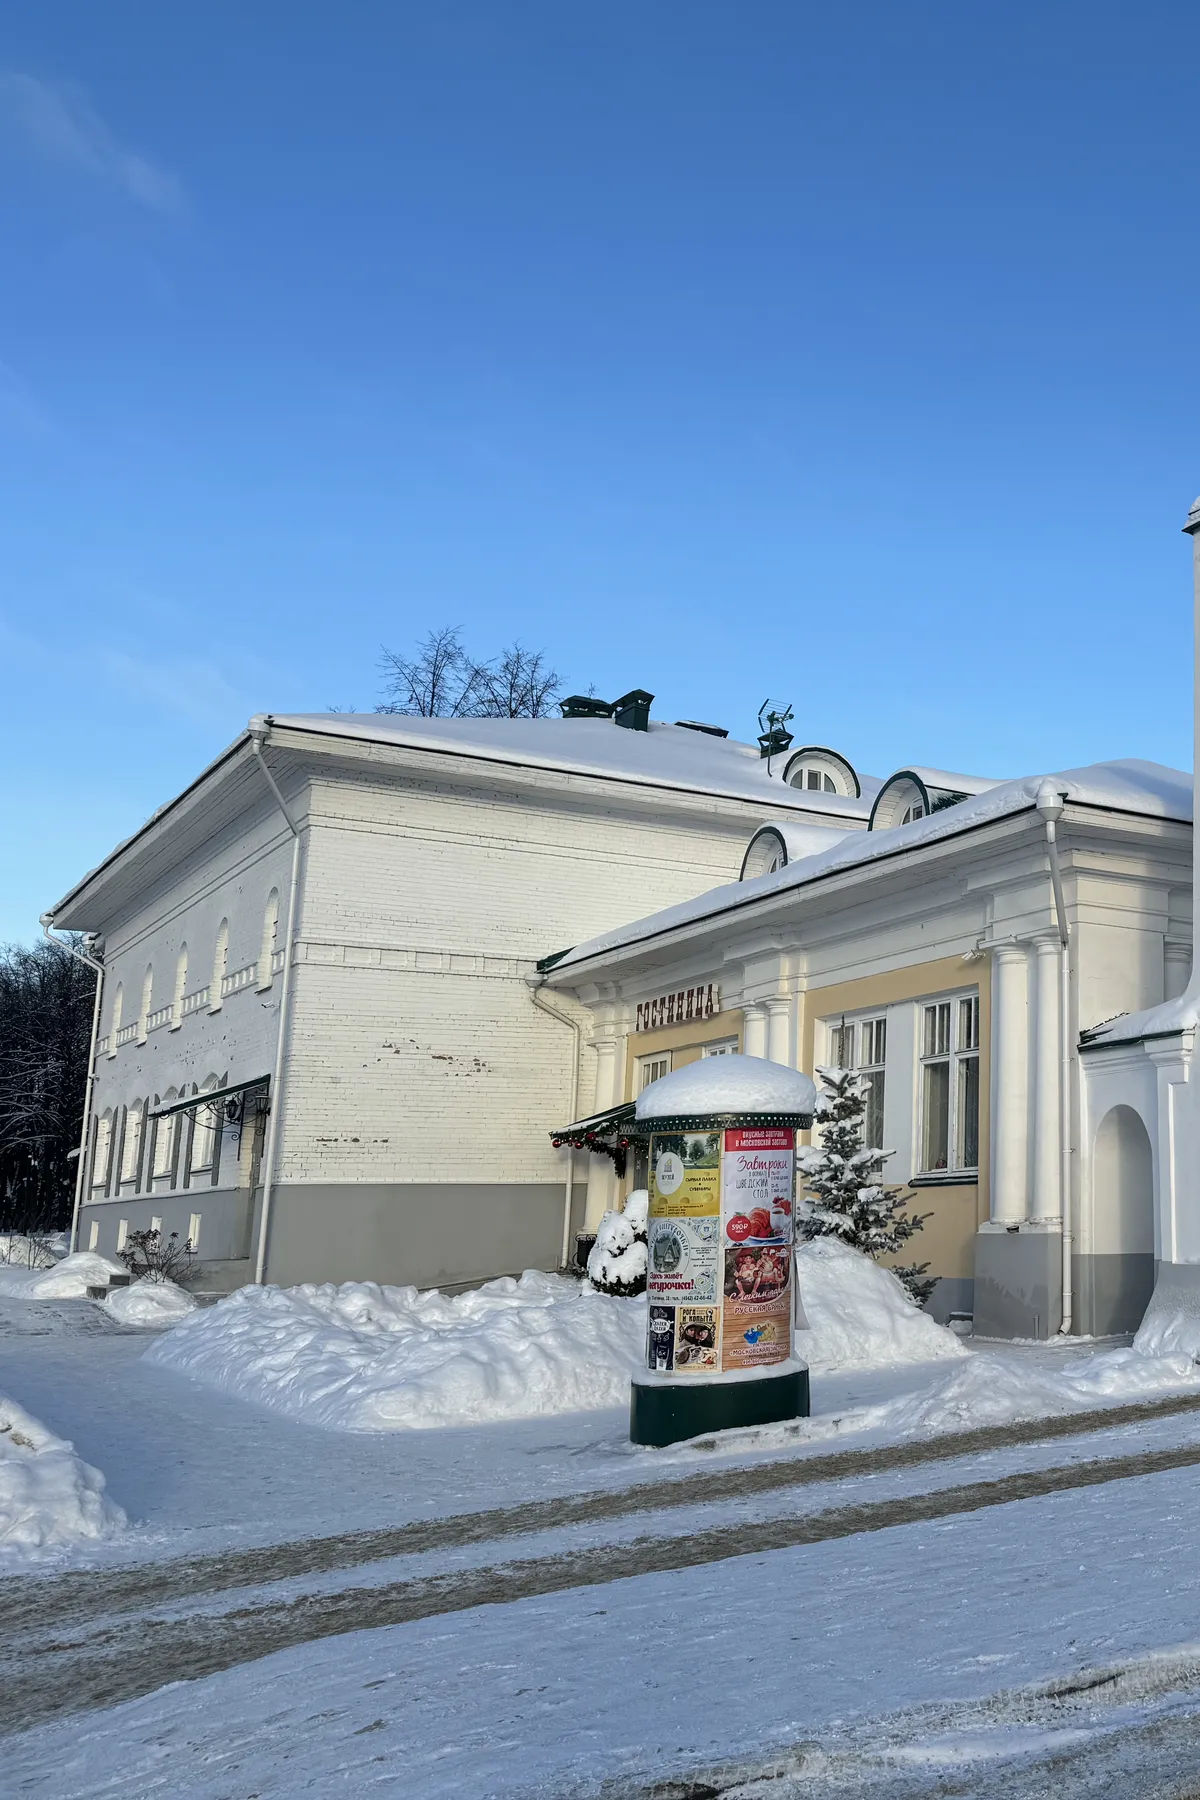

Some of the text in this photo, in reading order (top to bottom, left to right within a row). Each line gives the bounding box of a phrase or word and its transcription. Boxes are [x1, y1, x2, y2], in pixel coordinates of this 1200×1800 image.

[636, 984, 716, 1031] ГОСТИНИЦА
[736, 1156, 788, 1178] Завтраки
[735, 1178, 768, 1189] ШВЕДСКИЙ
[752, 1189, 769, 1198] СТОЛ
[734, 1305, 766, 1315] РУССКАЯ
